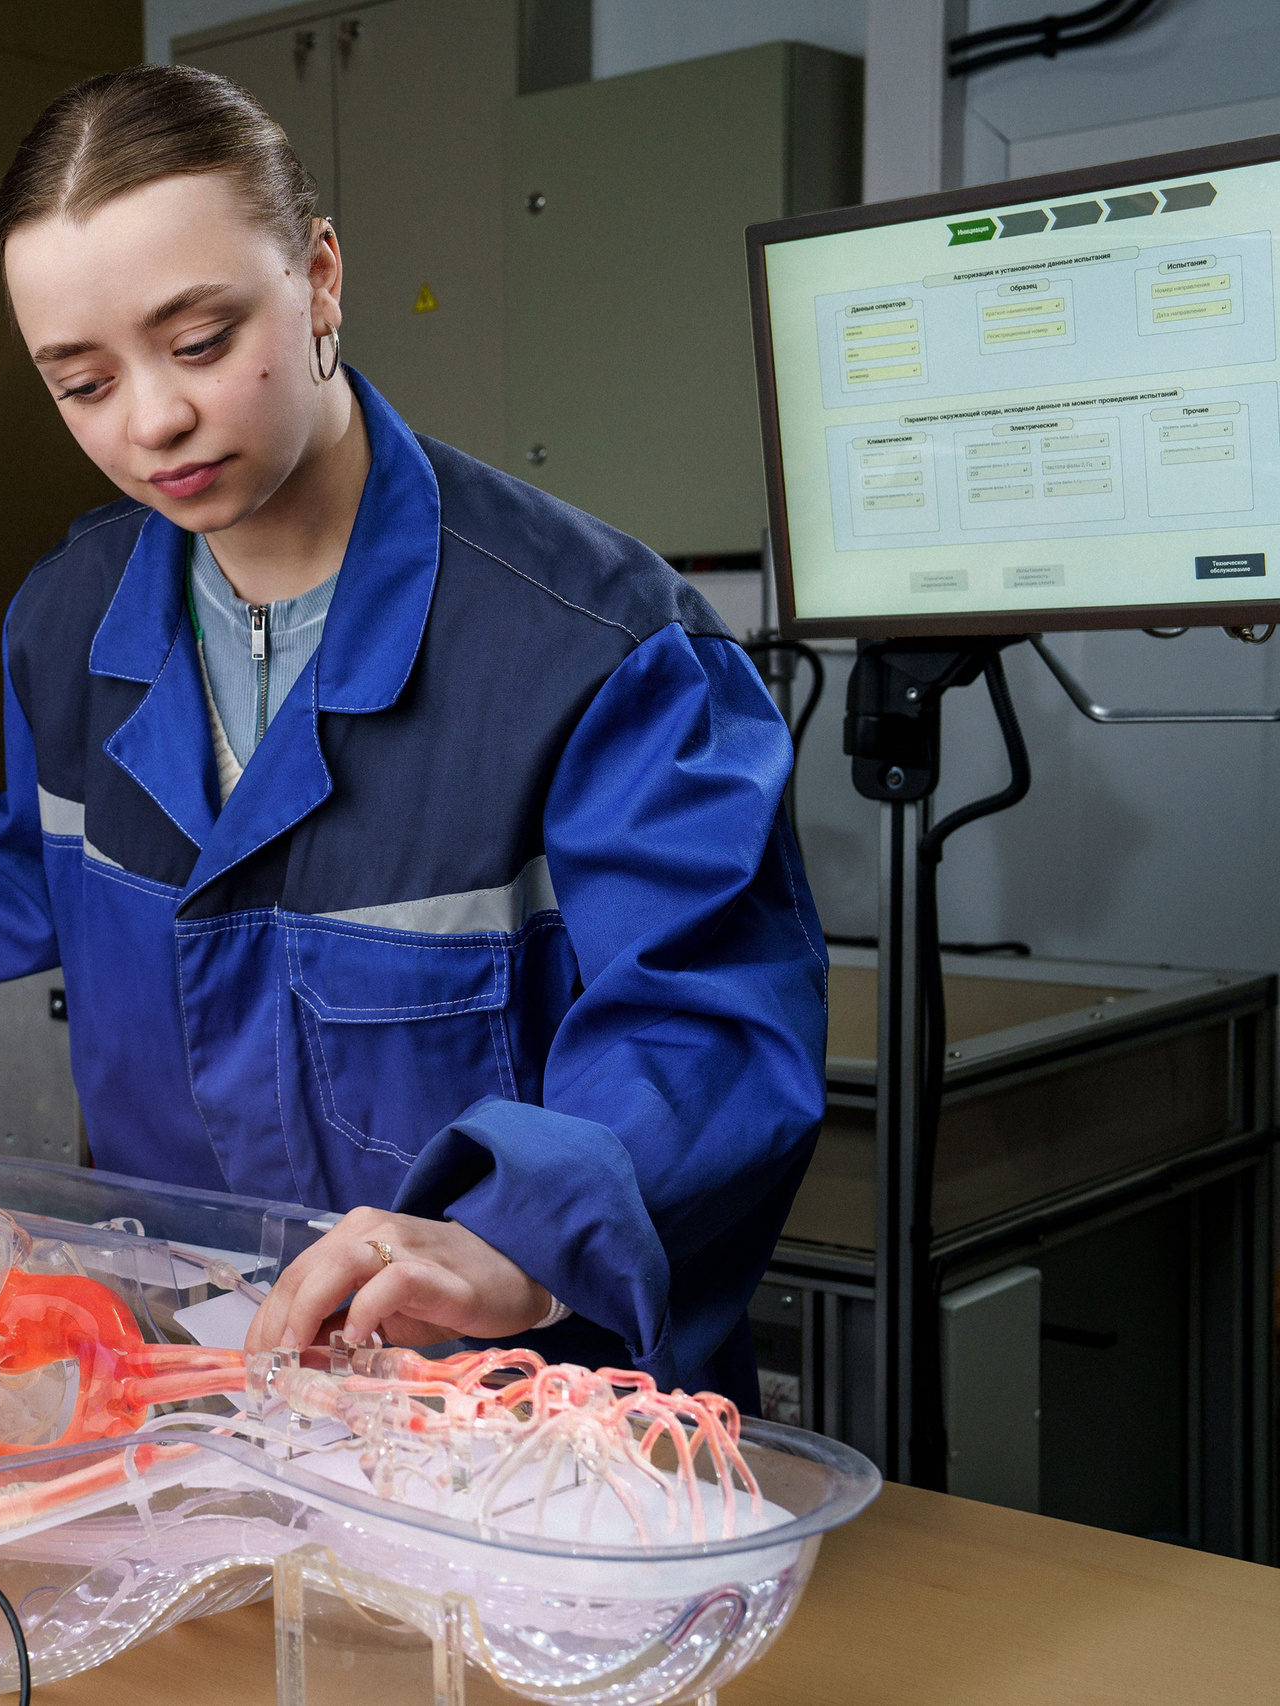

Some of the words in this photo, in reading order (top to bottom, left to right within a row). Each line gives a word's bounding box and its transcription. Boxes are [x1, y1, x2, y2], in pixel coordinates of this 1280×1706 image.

[953, 269, 994, 281] Авторизация
[1000, 262, 1046, 275] установочные
[1047, 258, 1073, 268] данные
[1074, 252, 1111, 264] испытания
[1167, 259, 1208, 270] Испытание
[1010, 283, 1038, 292] Образец
[1154, 285, 1174, 294] Номер
[1174, 282, 1210, 291] направления
[851, 306, 874, 314] Данные
[875, 300, 906, 310] оператора
[904, 414, 938, 424] Параметры
[940, 410, 980, 420] окружающей
[981, 408, 1002, 417] среды,
[1004, 406, 1035, 414] исходные
[1036, 403, 1061, 412] данные
[1071, 399, 1098, 407] момент
[1098, 394, 1138, 405] проведения
[1140, 390, 1178, 400] испытаний
[1182, 407, 1209, 416] Прочие
[1010, 422, 1058, 432] Электрические
[866, 436, 912, 444] Климатические
